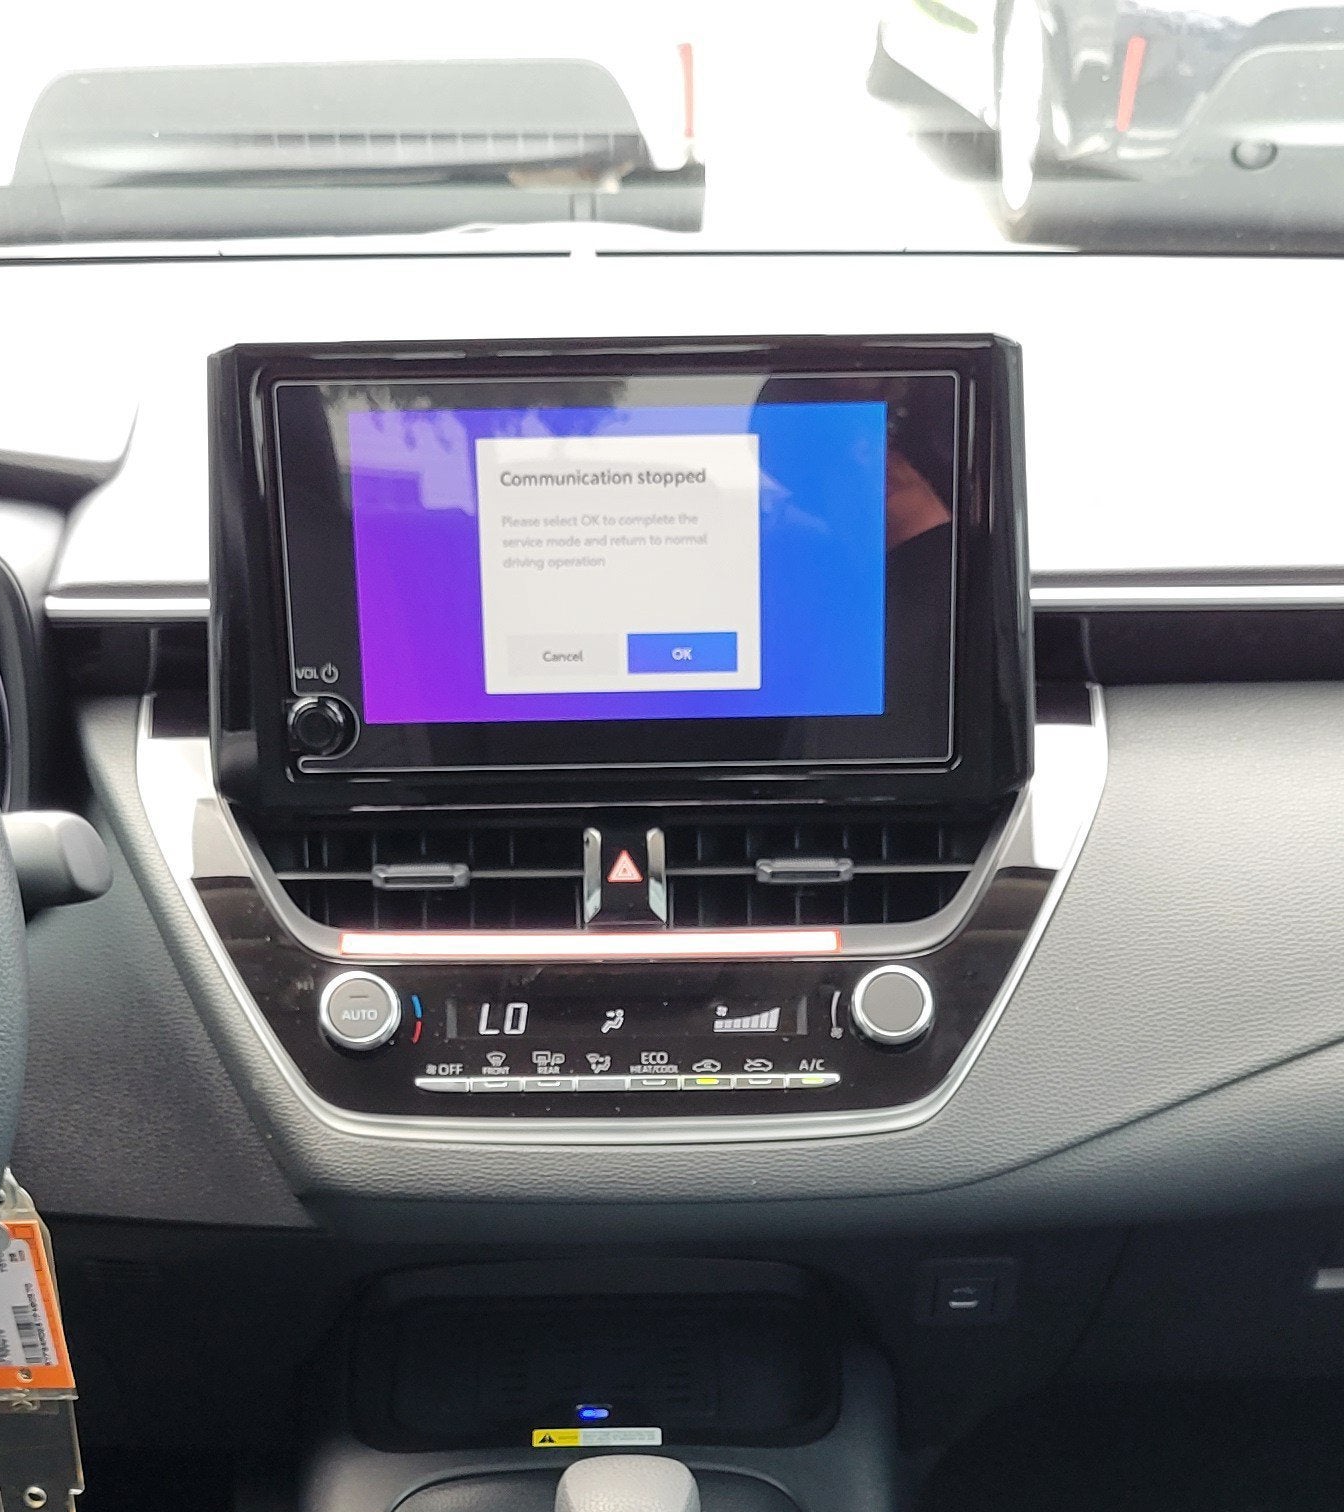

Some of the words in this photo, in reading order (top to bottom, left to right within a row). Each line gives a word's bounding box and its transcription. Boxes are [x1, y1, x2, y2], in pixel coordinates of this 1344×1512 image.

[499, 468, 633, 487] Communication
[637, 467, 707, 488] stopped
[501, 515, 541, 528] Please
[542, 514, 578, 527] select
[581, 514, 600, 527] OK
[602, 515, 616, 526] to
[618, 513, 676, 528] complete
[678, 512, 699, 526] the
[502, 536, 544, 548] service
[546, 535, 582, 547] mode
[583, 534, 607, 547] and
[609, 534, 647, 547] return
[649, 534, 662, 546] to
[664, 533, 707, 546] normal
[502, 556, 545, 570] driving
[541, 650, 584, 663] Cancel
[671, 647, 693, 661] OK
[295, 666, 320, 680] VOL
[341, 1008, 378, 1021] AUTO
[639, 1051, 669, 1065] ECO
[798, 1058, 825, 1072] A/C
[437, 1063, 464, 1076] OFF
[481, 1065, 510, 1075] FRONT
[536, 1065, 560, 1075] REAR
[628, 1064, 679, 1075] HEAT/COOL
